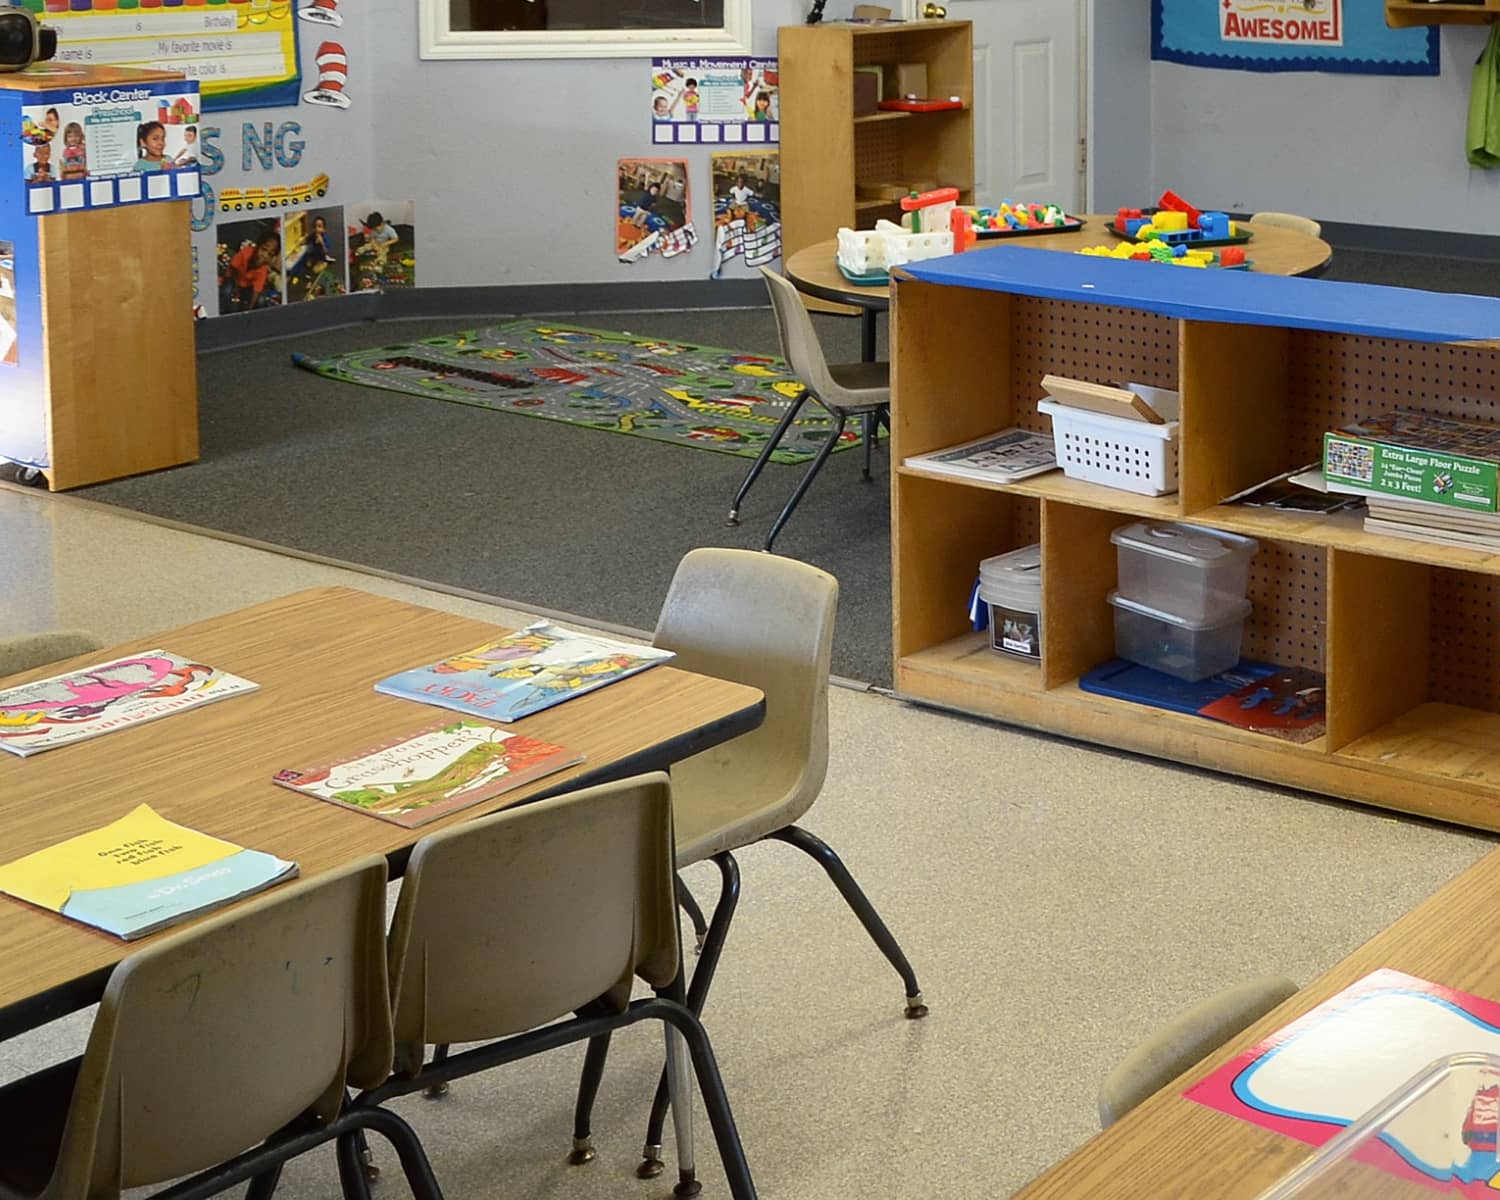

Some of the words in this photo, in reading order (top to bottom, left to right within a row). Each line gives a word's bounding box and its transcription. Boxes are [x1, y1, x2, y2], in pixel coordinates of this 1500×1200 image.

[1224, 12, 1331, 40] AWESOME
[699, 60, 747, 69] Movement
[72, 91, 108, 106] Block
[110, 88, 152, 103] Center
[1382, 450, 1402, 462] Extra
[1405, 454, 1428, 467] Large
[1430, 458, 1452, 469] Floor
[1453, 461, 1480, 474] Puzzle
[97, 847, 121, 857] One
[123, 838, 148, 850] fish
[137, 846, 161, 858] fish
[139, 840, 164, 850] fish
[159, 845, 183, 857] fish
